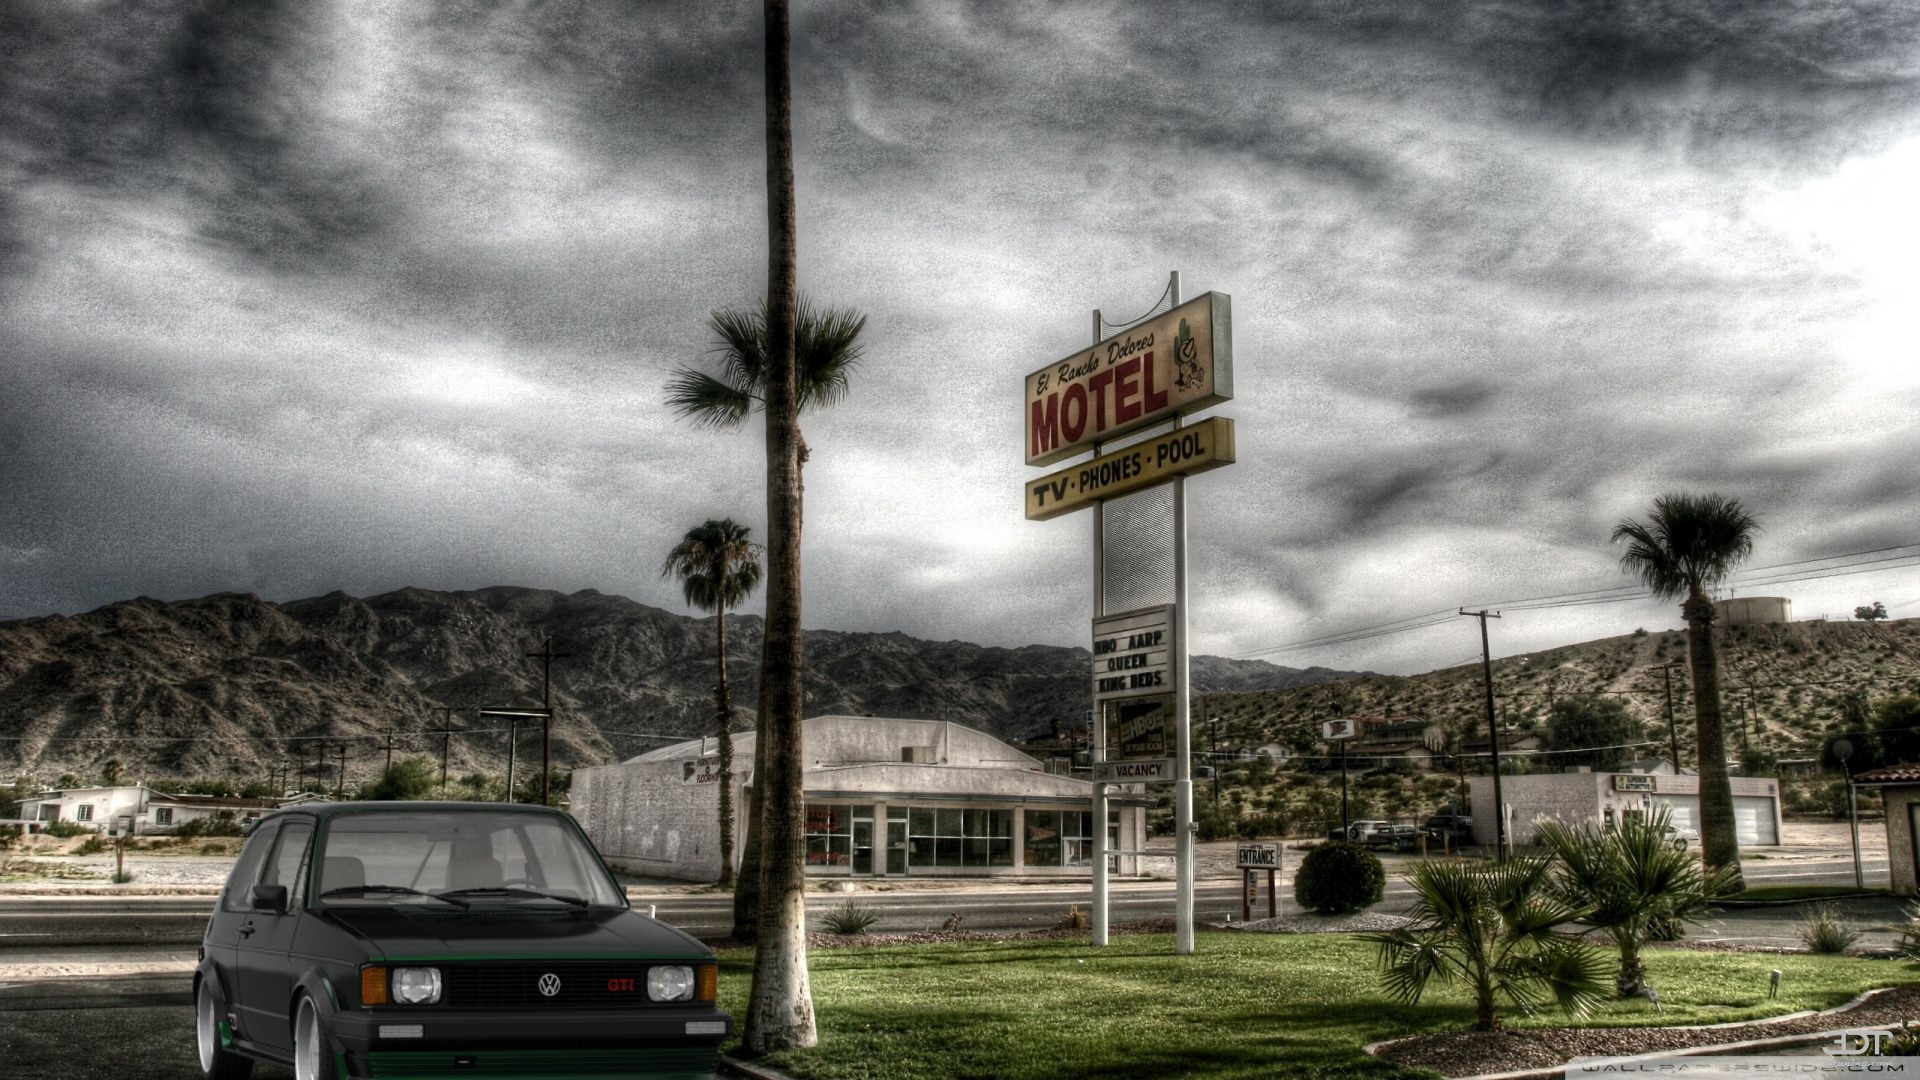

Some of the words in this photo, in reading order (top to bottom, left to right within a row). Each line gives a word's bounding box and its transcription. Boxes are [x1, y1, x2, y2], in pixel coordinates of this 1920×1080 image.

[1037, 374, 1050, 395] El
[1057, 352, 1099, 385] Rancho
[1107, 333, 1154, 365] Dolores
[1032, 351, 1168, 457] MOTEL
[1034, 477, 1068, 507] TV
[1080, 452, 1141, 493] PHONES
[1157, 432, 1205, 468] POOL
[1128, 631, 1162, 650] AARP
[1108, 653, 1147, 672] QUEEN
[1099, 676, 1126, 693] KING
[1130, 670, 1162, 689] BEDS
[1128, 711, 1157, 738] HBO
[1116, 764, 1162, 777] VACANCY
[1239, 849, 1275, 865] ENTRANCE
[608, 979, 635, 992] GTI
